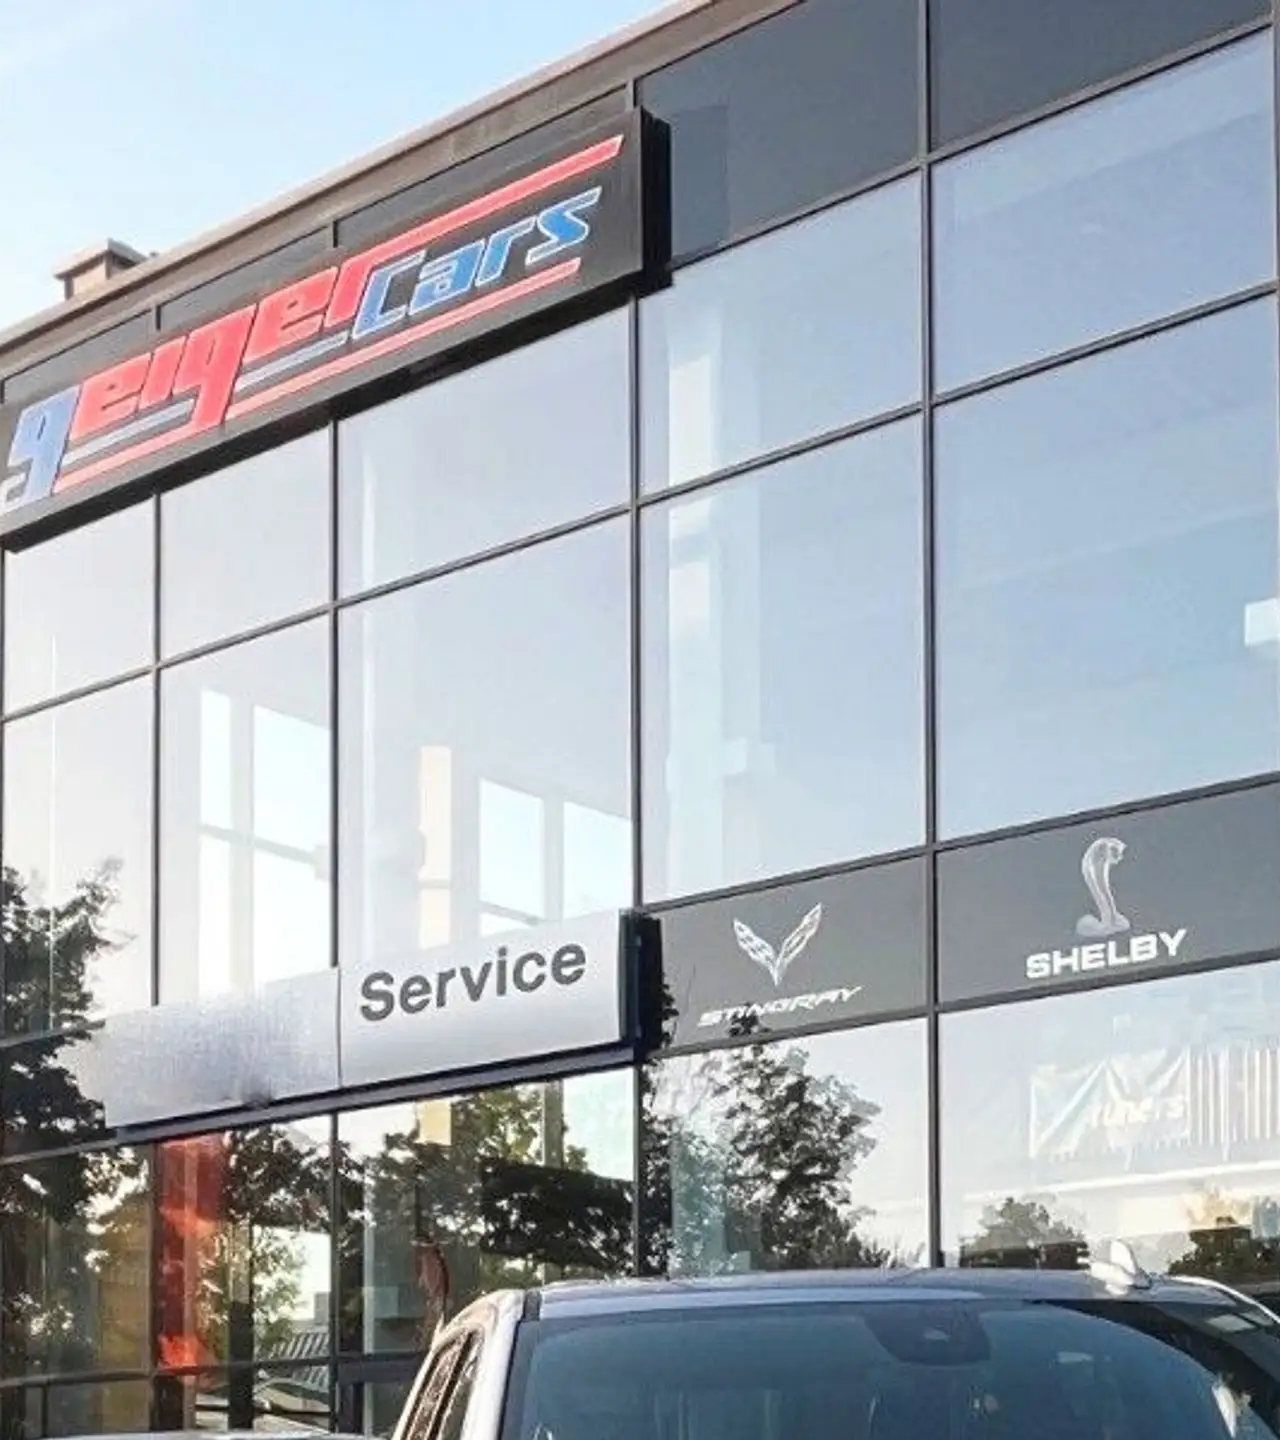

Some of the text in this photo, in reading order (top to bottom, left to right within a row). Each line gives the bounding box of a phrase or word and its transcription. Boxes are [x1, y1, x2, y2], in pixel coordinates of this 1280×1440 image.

[1026, 928, 1187, 980] SHELBY
[359, 941, 587, 1022] Service
[696, 985, 864, 1028] STINGRAY
